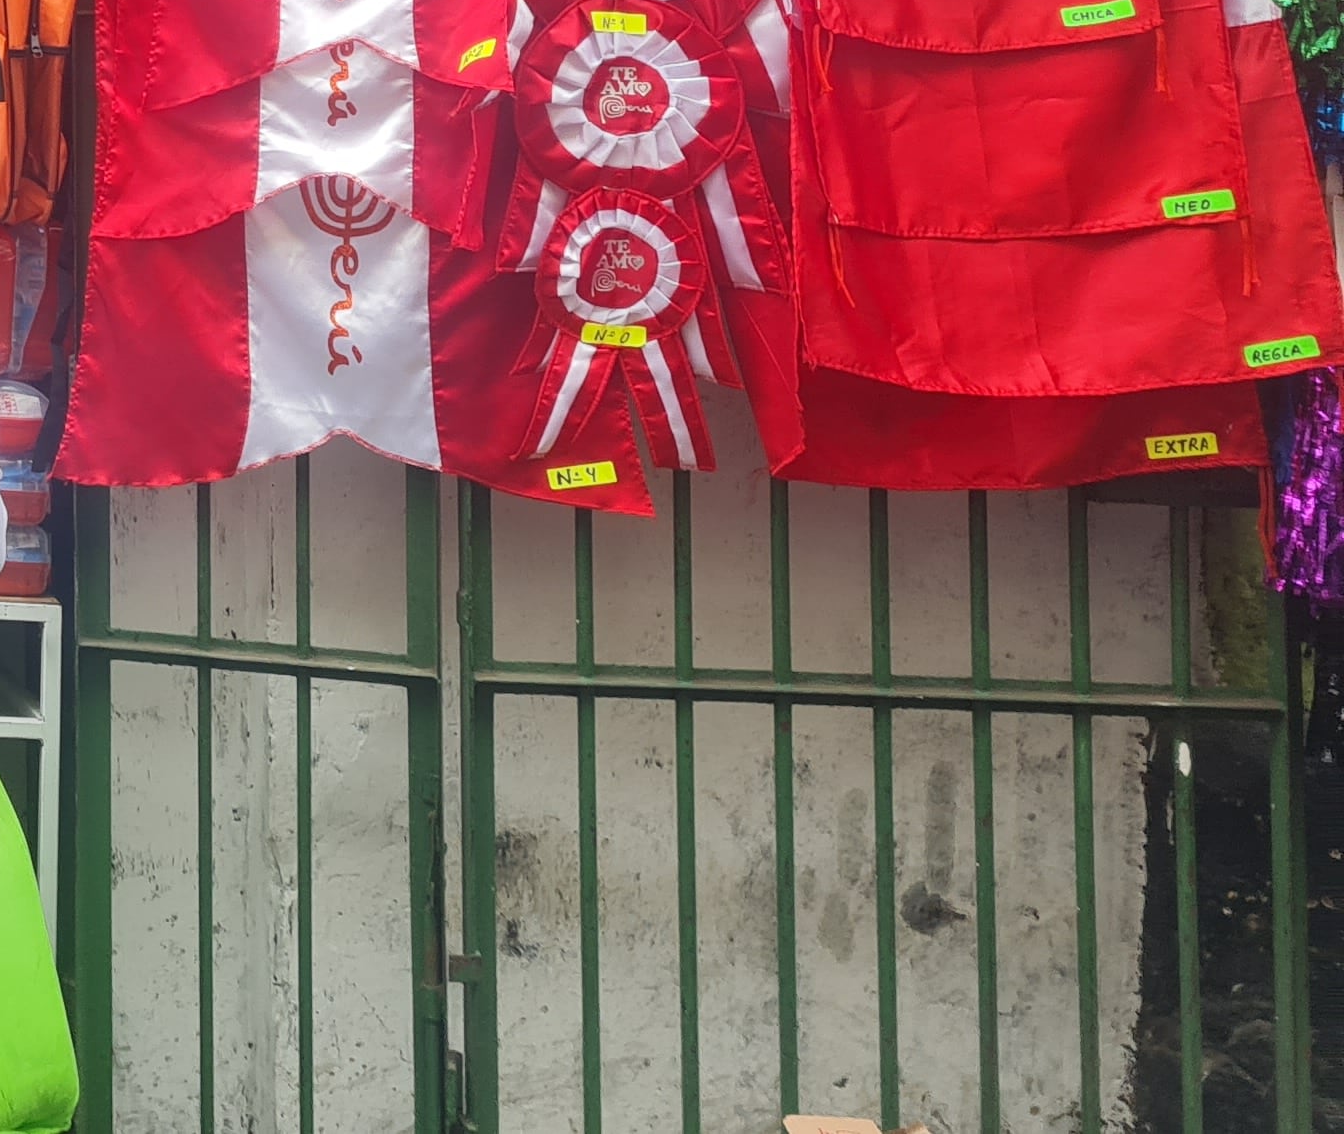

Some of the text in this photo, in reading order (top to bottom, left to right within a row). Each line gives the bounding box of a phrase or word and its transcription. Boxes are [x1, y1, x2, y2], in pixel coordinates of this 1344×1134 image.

[1070, 7, 1114, 22] CHICA
[609, 66, 638, 82] TE
[603, 239, 631, 254] TE
[1251, 340, 1303, 363] REGLA
[1153, 436, 1211, 456] EXTRA
